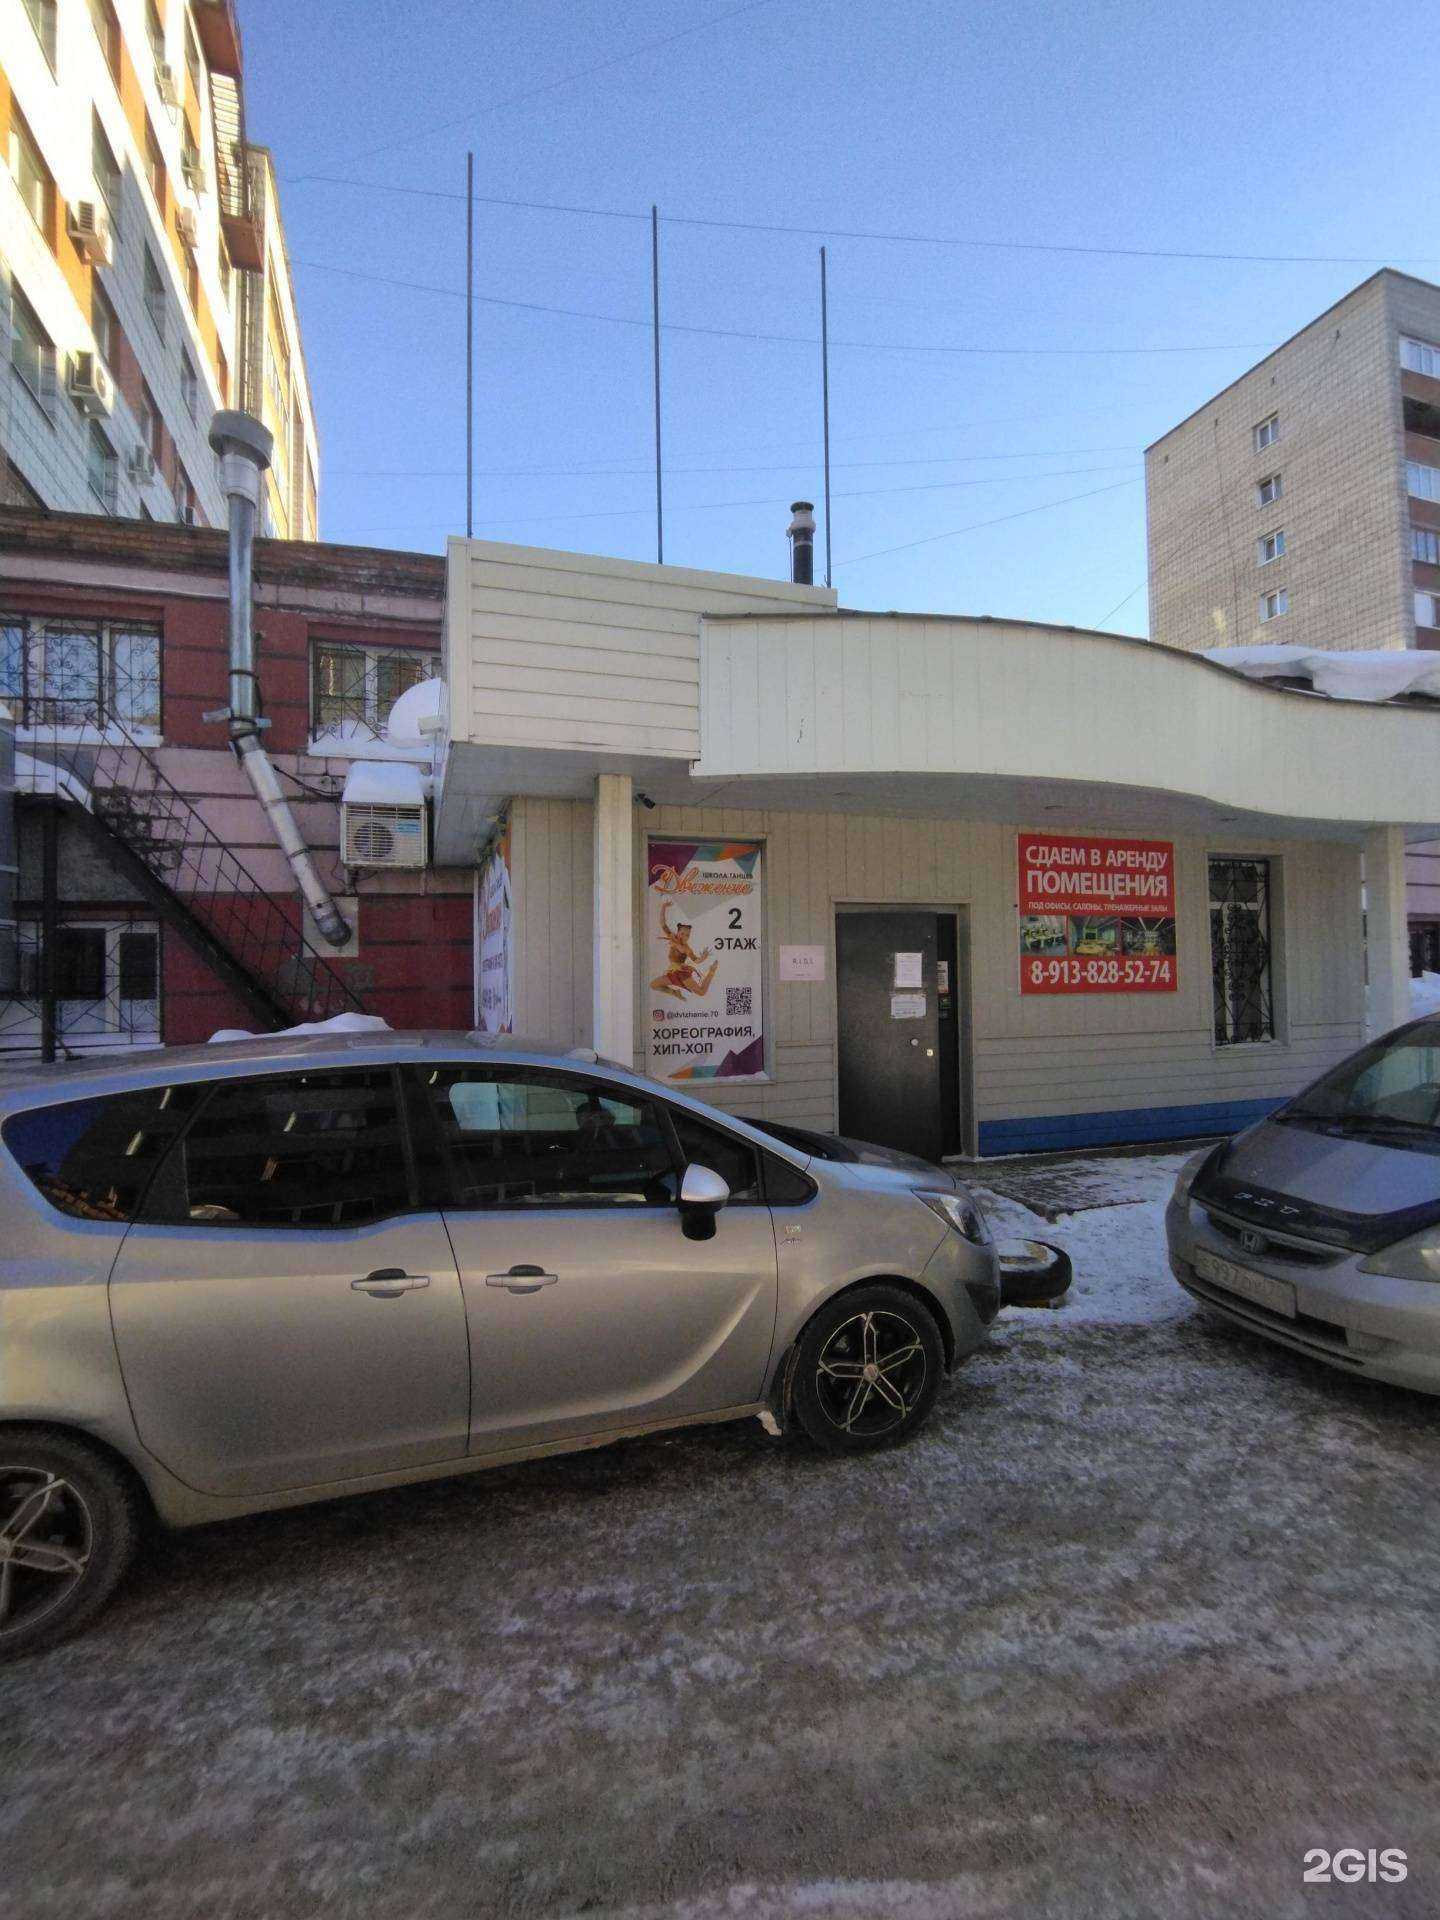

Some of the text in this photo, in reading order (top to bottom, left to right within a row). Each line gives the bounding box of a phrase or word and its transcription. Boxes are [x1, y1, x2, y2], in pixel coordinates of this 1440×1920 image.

[1026, 845, 1168, 872] СДАЕМ В АРЕНДУ
[702, 871, 728, 880] ШКОЛА
[1026, 869, 1168, 900] ПОМЕЩЕНИЯ
[1028, 901, 1044, 910] ПОД
[727, 907, 744, 930] 2
[714, 937, 758, 951] ЭТАЖ
[1031, 960, 1171, 984] 8-913-828-52-74
[652, 1025, 756, 1040] ХОРЕОГРАФИЯ,
[652, 1042, 713, 1056] ХИП-ХОП
